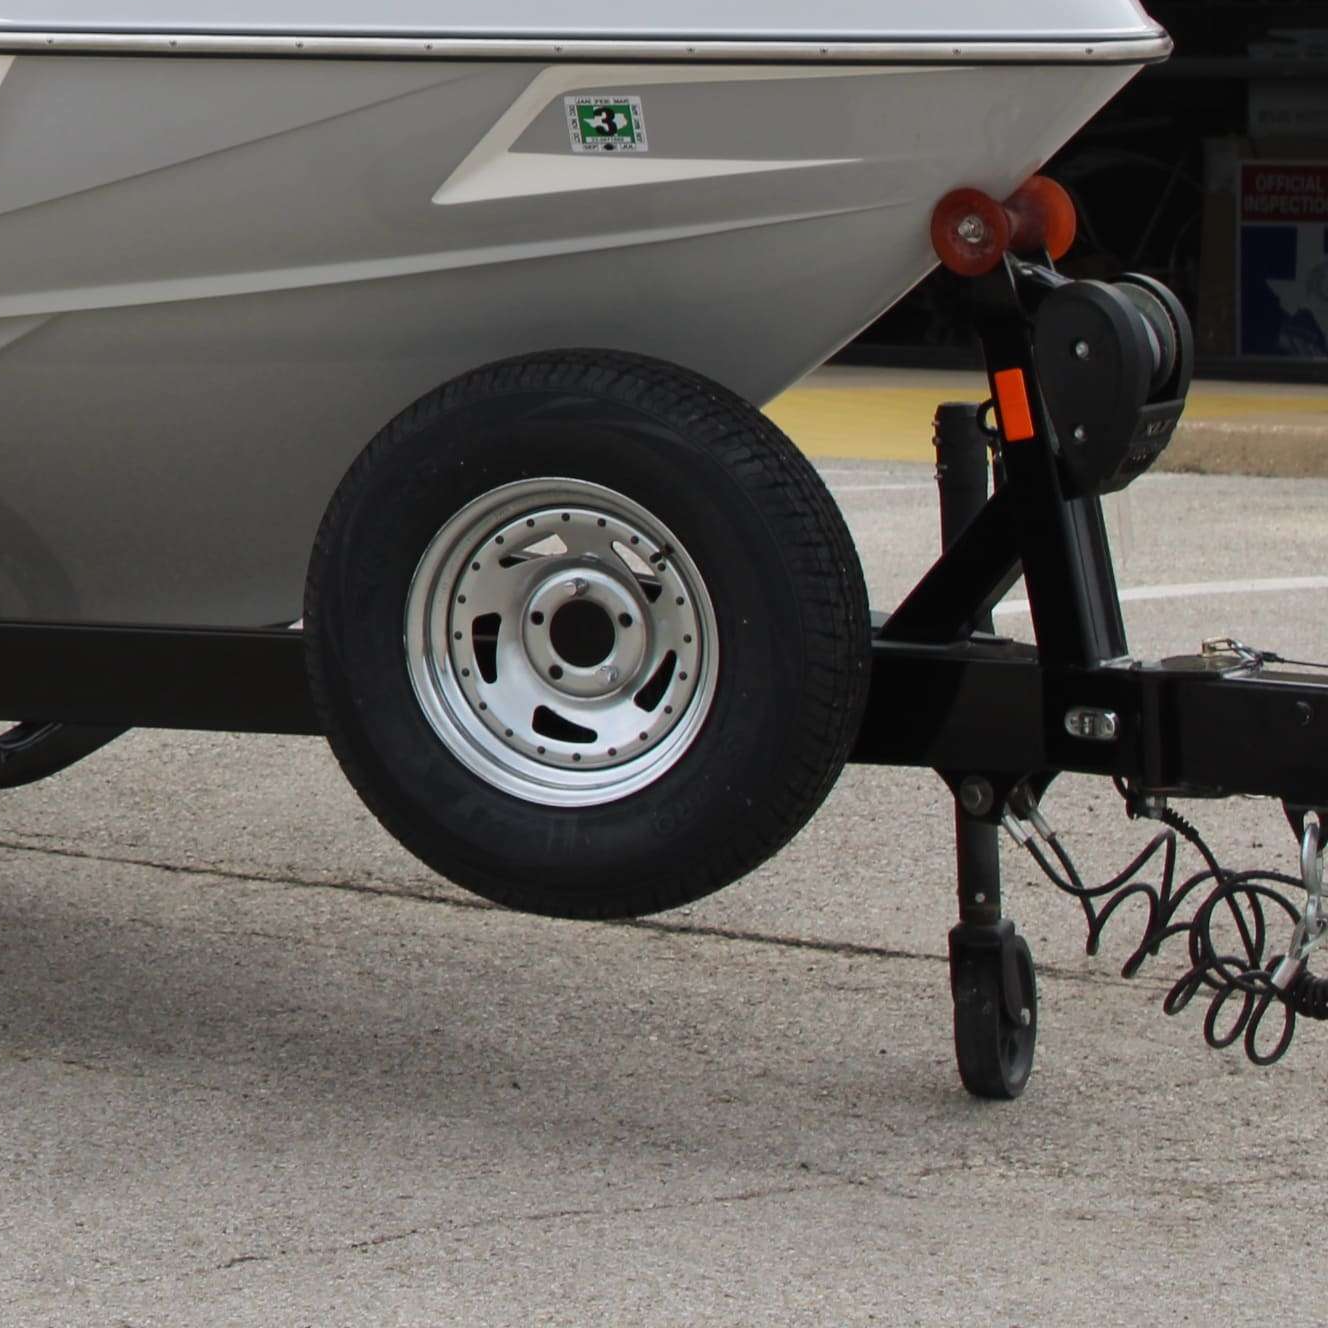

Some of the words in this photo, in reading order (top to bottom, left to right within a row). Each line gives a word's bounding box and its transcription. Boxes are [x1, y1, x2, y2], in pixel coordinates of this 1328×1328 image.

[592, 106, 618, 138] 3
[1255, 172, 1326, 193] OFFICIAL
[1243, 194, 1328, 214] INSPECTIO
